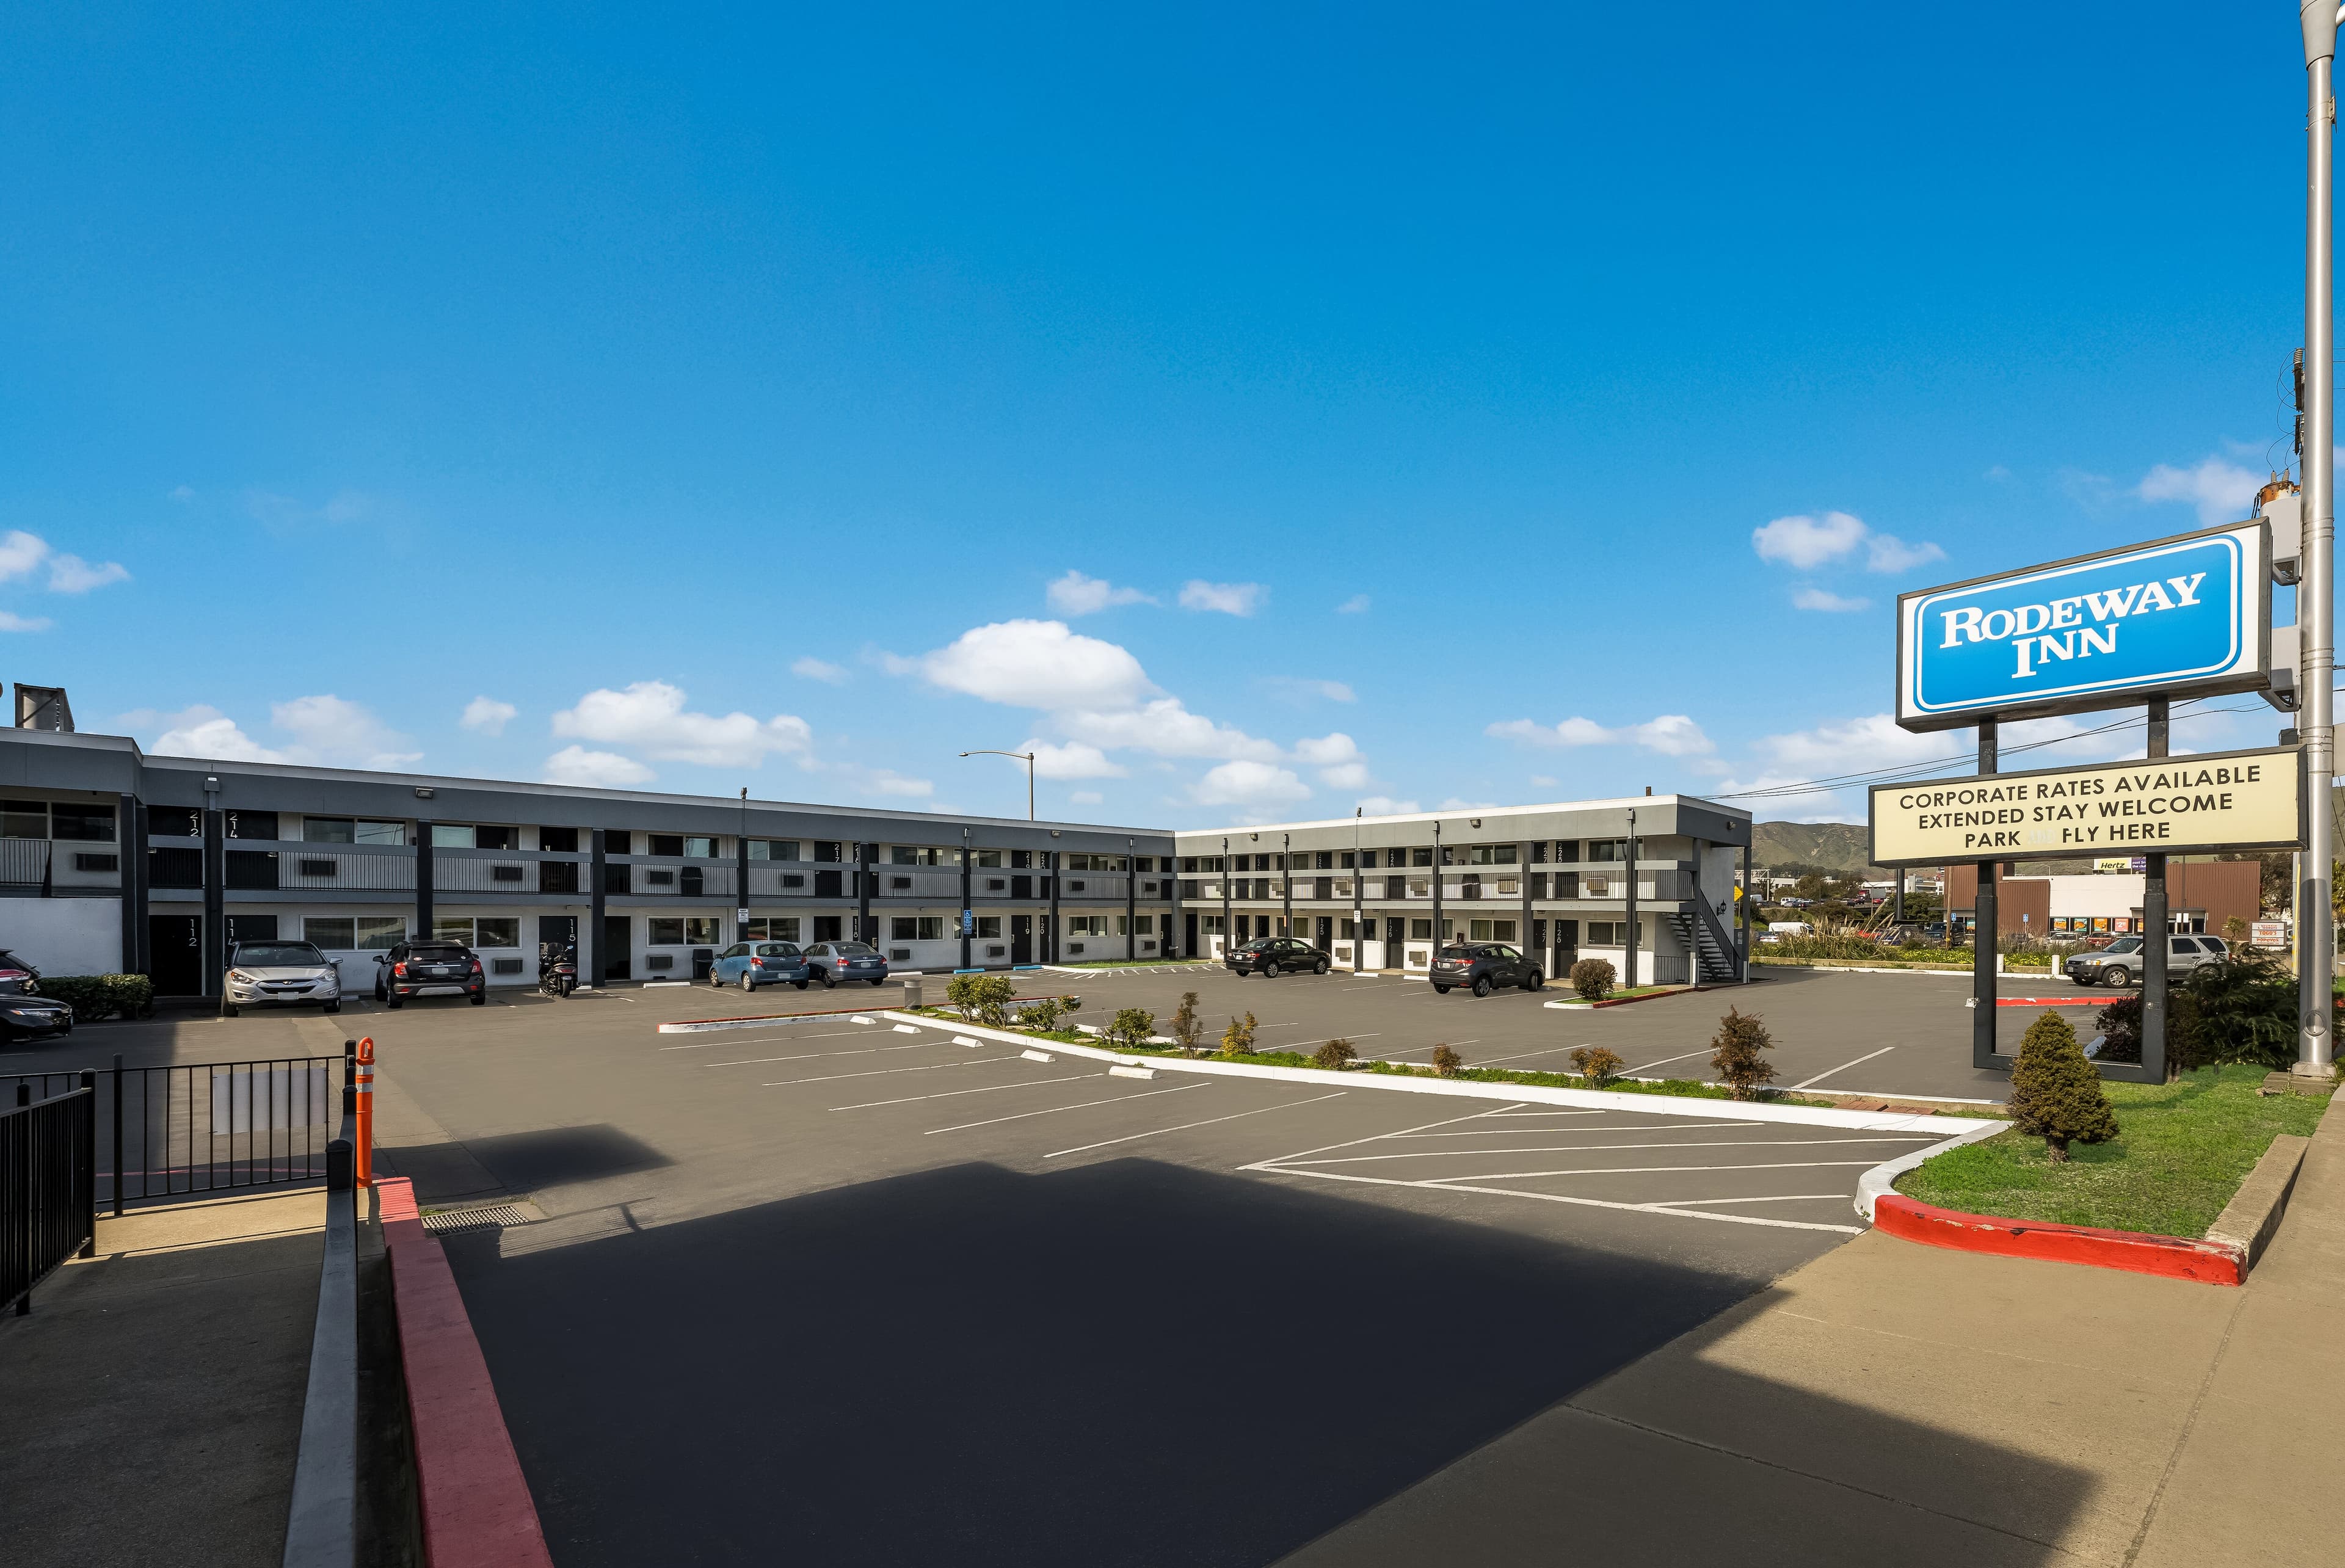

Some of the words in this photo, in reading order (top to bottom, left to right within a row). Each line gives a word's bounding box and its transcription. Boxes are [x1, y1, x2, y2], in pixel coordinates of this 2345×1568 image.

[1940, 572, 2206, 649] RODEWAY
[2012, 623, 2120, 678] INN
[1900, 785, 2027, 809] CORPORATE
[2037, 779, 2104, 799] RATES
[2114, 765, 2260, 793] AVAILABLE
[189, 810, 198, 837] 212
[229, 812, 238, 838] 214
[1919, 808, 2024, 829] EXTENDED
[2033, 803, 2089, 822] STAY
[2098, 793, 2232, 818] WELCOME
[1965, 830, 2021, 848] PARK
[2062, 826, 2099, 843] FLY
[2110, 822, 2169, 841] HERE
[189, 919, 197, 946] 112
